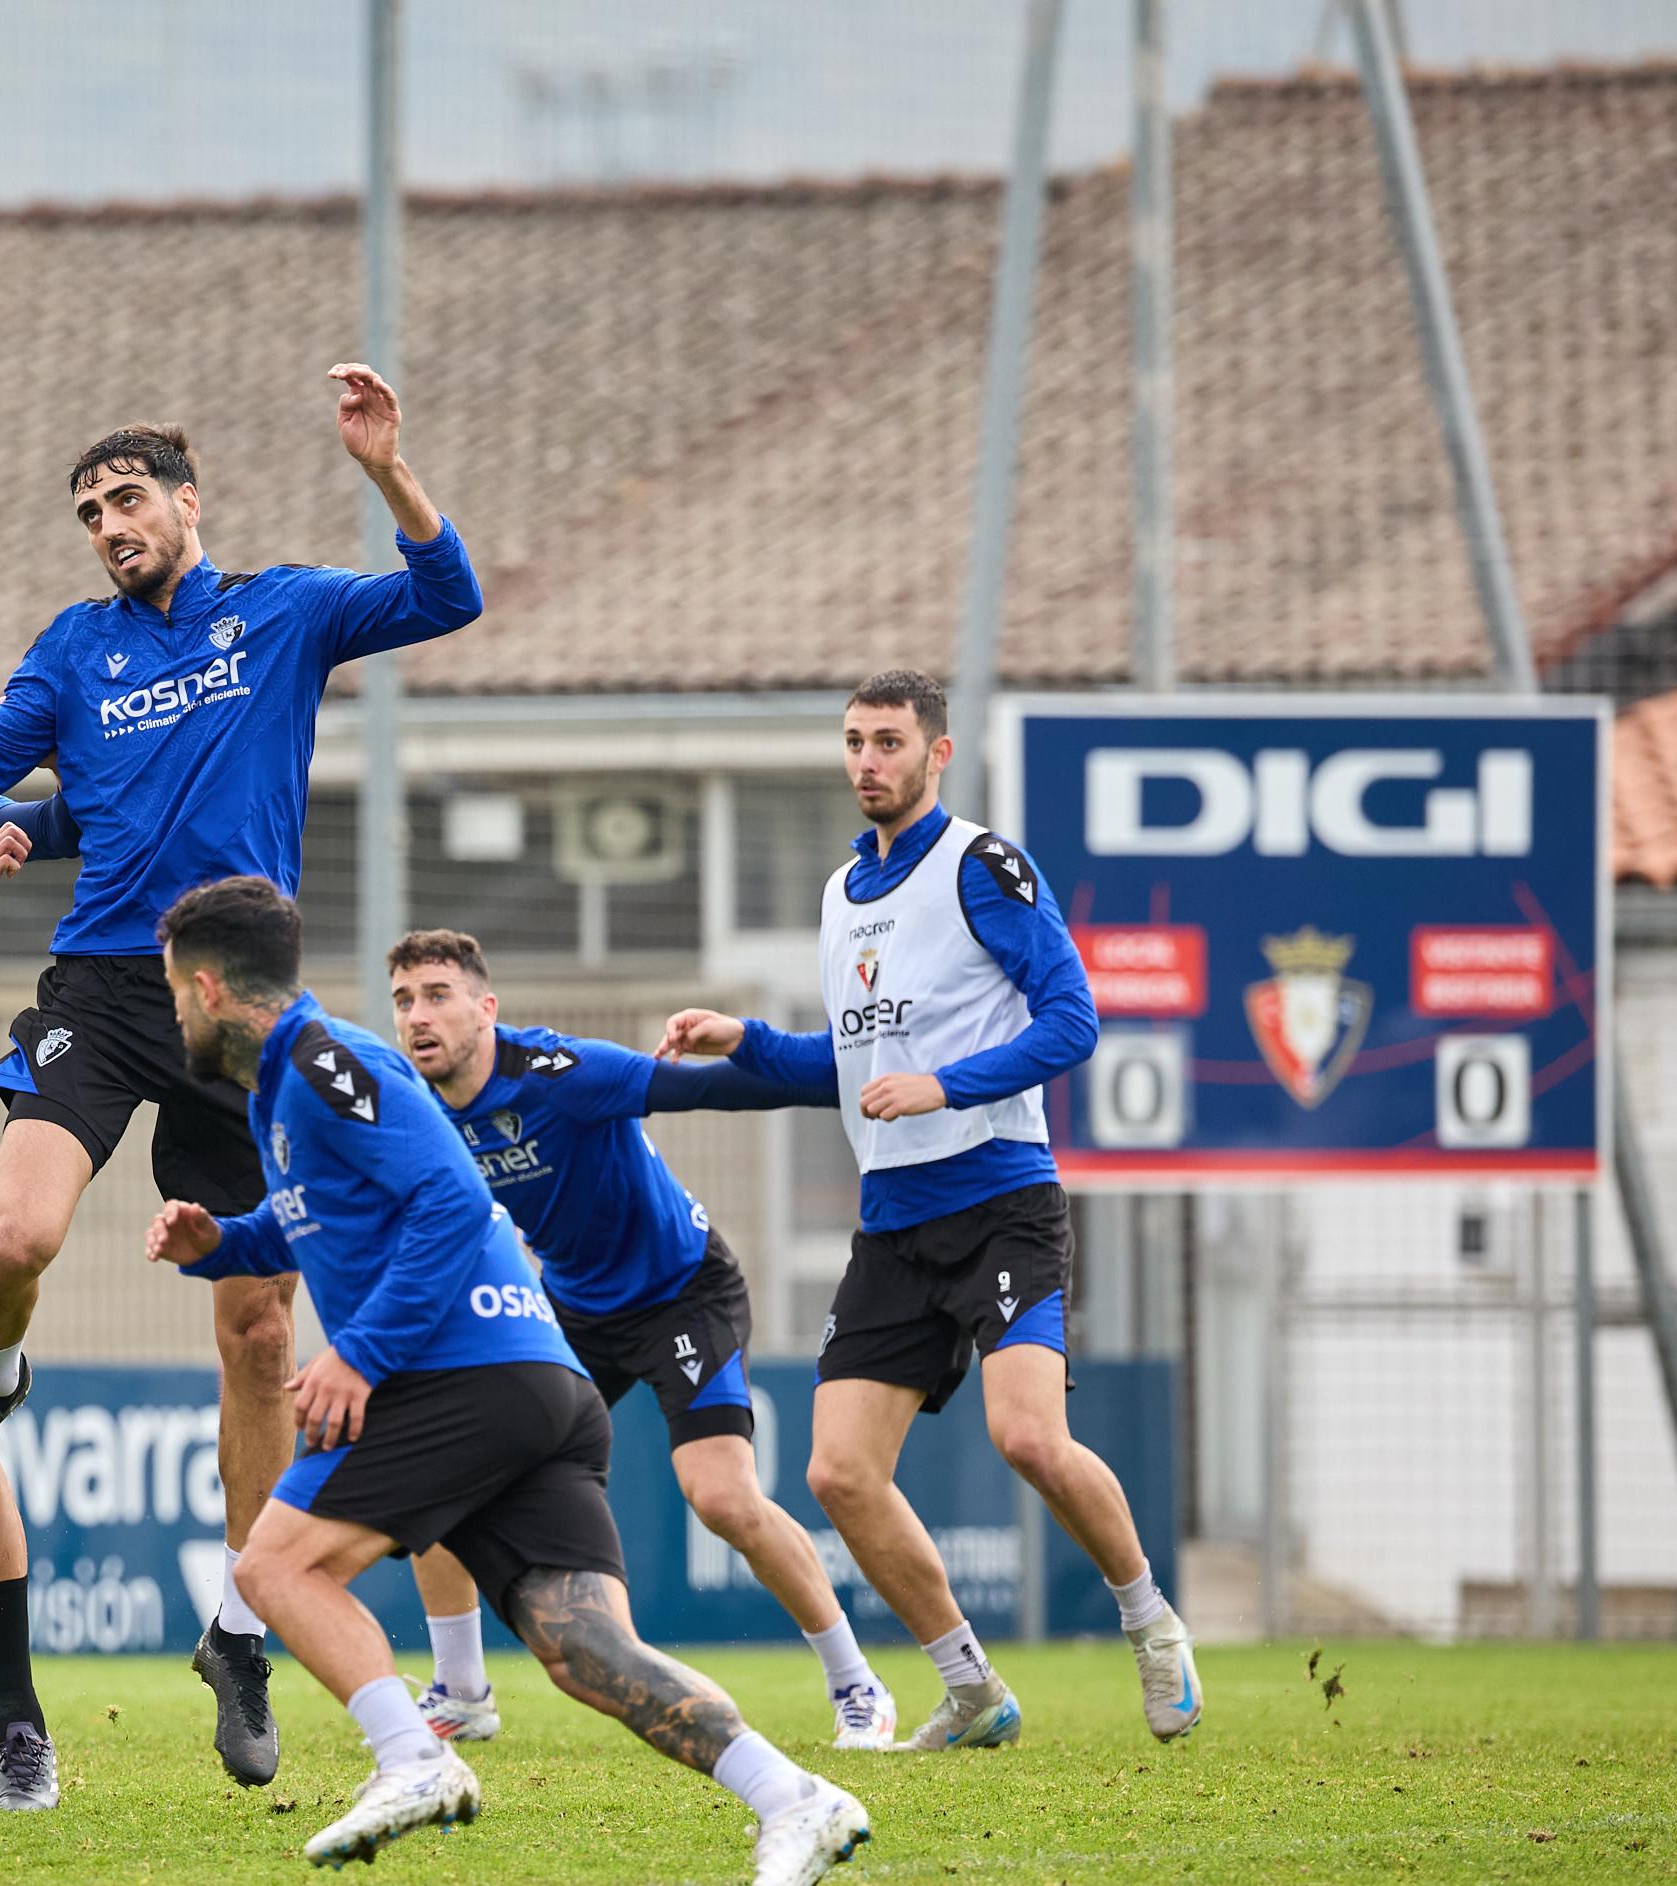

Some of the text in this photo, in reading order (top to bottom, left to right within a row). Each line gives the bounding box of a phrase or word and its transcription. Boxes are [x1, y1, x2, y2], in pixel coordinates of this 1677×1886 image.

[100, 651, 247, 725] kosner
[203, 685, 252, 706] eficiente
[1085, 748, 1532, 856] DIGI
[1453, 1055, 1507, 1128] 0
[997, 1270, 1011, 1292] 9
[673, 1333, 697, 1360] 11
